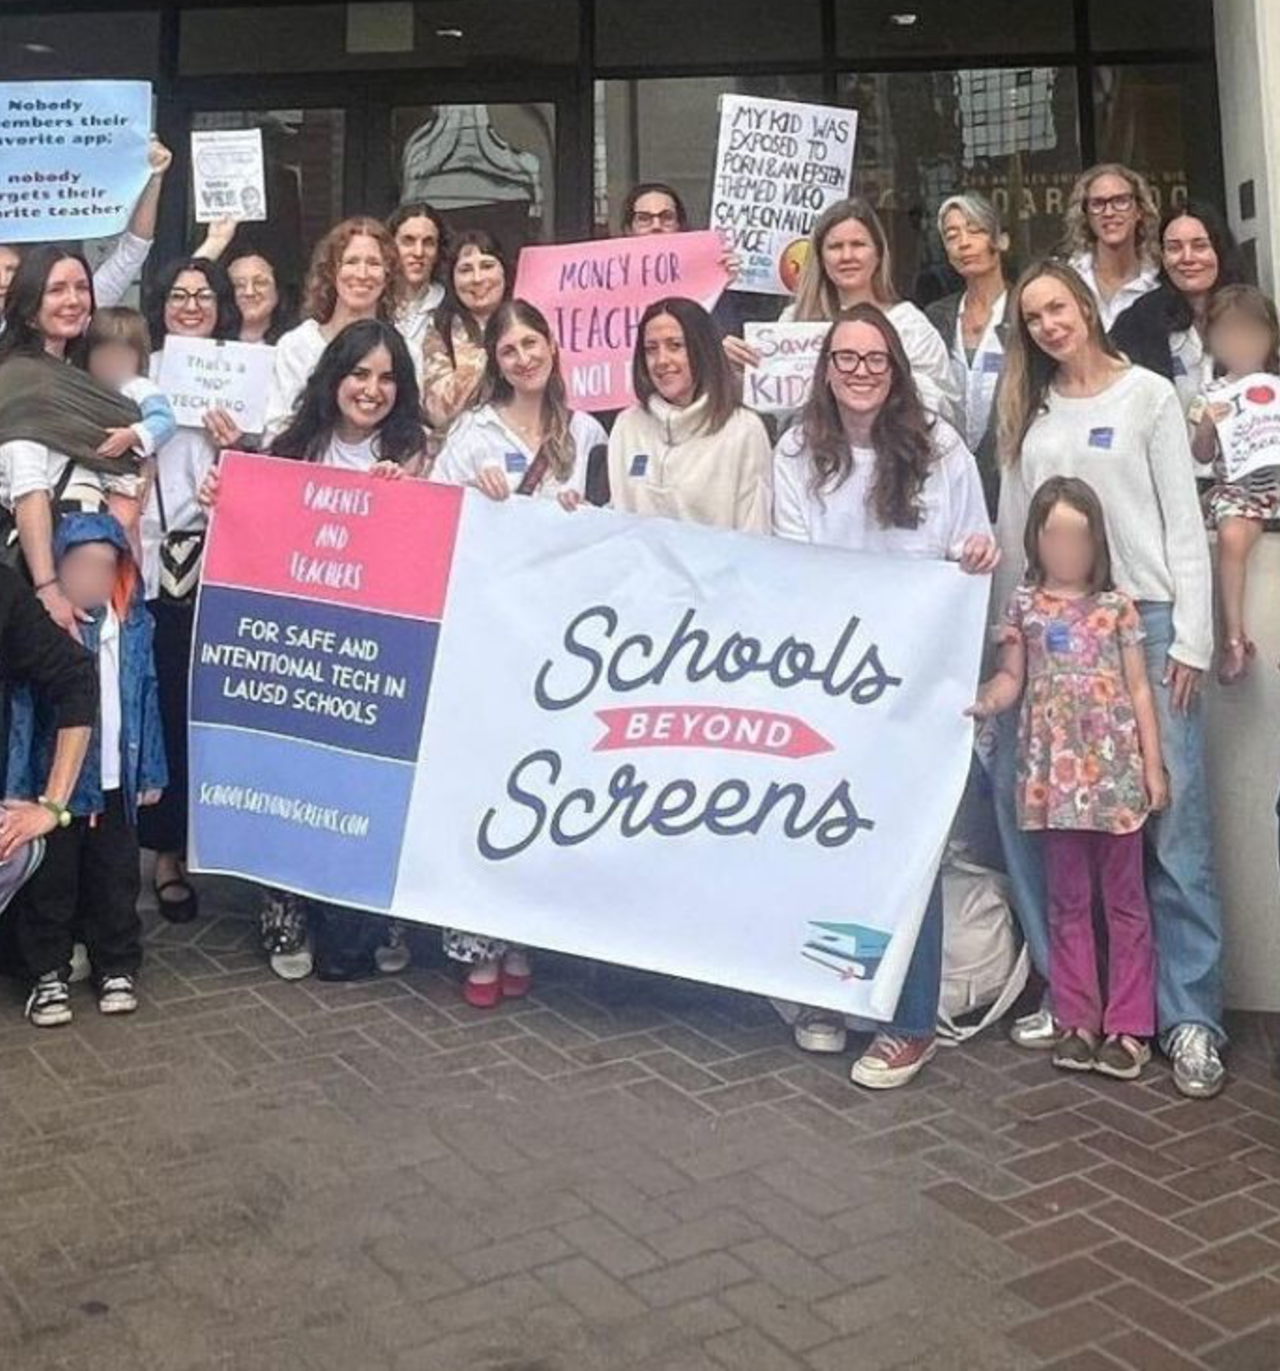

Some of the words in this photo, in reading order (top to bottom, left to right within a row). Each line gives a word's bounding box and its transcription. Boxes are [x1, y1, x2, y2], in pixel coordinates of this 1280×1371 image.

[8, 98, 83, 112] Nobody
[81, 114, 129, 127] their
[732, 106, 767, 129] MY
[769, 110, 803, 134] KID
[813, 116, 849, 144] WAS
[729, 129, 798, 158] EXPOSED
[807, 140, 828, 161] TO
[8, 171, 82, 184] nobody
[722, 152, 765, 177] PORN
[57, 187, 108, 200] their
[783, 182, 825, 210] VIDEO
[715, 201, 760, 228] GAME
[558, 253, 630, 291] MONEY
[642, 251, 682, 284] FOR
[555, 305, 640, 353] TEACH
[756, 329, 824, 358] Save
[572, 362, 610, 398] NOT
[750, 372, 812, 407] KID
[172, 393, 210, 410] TECH
[303, 480, 371, 516] PARENTS
[315, 524, 349, 550] AND
[290, 551, 363, 590] TEACHERS
[238, 617, 280, 644] FOR
[285, 625, 337, 653] SAFE
[338, 637, 379, 662] AND
[201, 643, 325, 683] INTENTIONAL
[331, 663, 380, 694] TECH
[383, 675, 407, 699] IN
[534, 604, 903, 711] Schools
[223, 677, 288, 706] LAUSD
[292, 689, 379, 726] SCHOOLS
[624, 712, 794, 748] BEYOND
[477, 749, 876, 862] Screens
